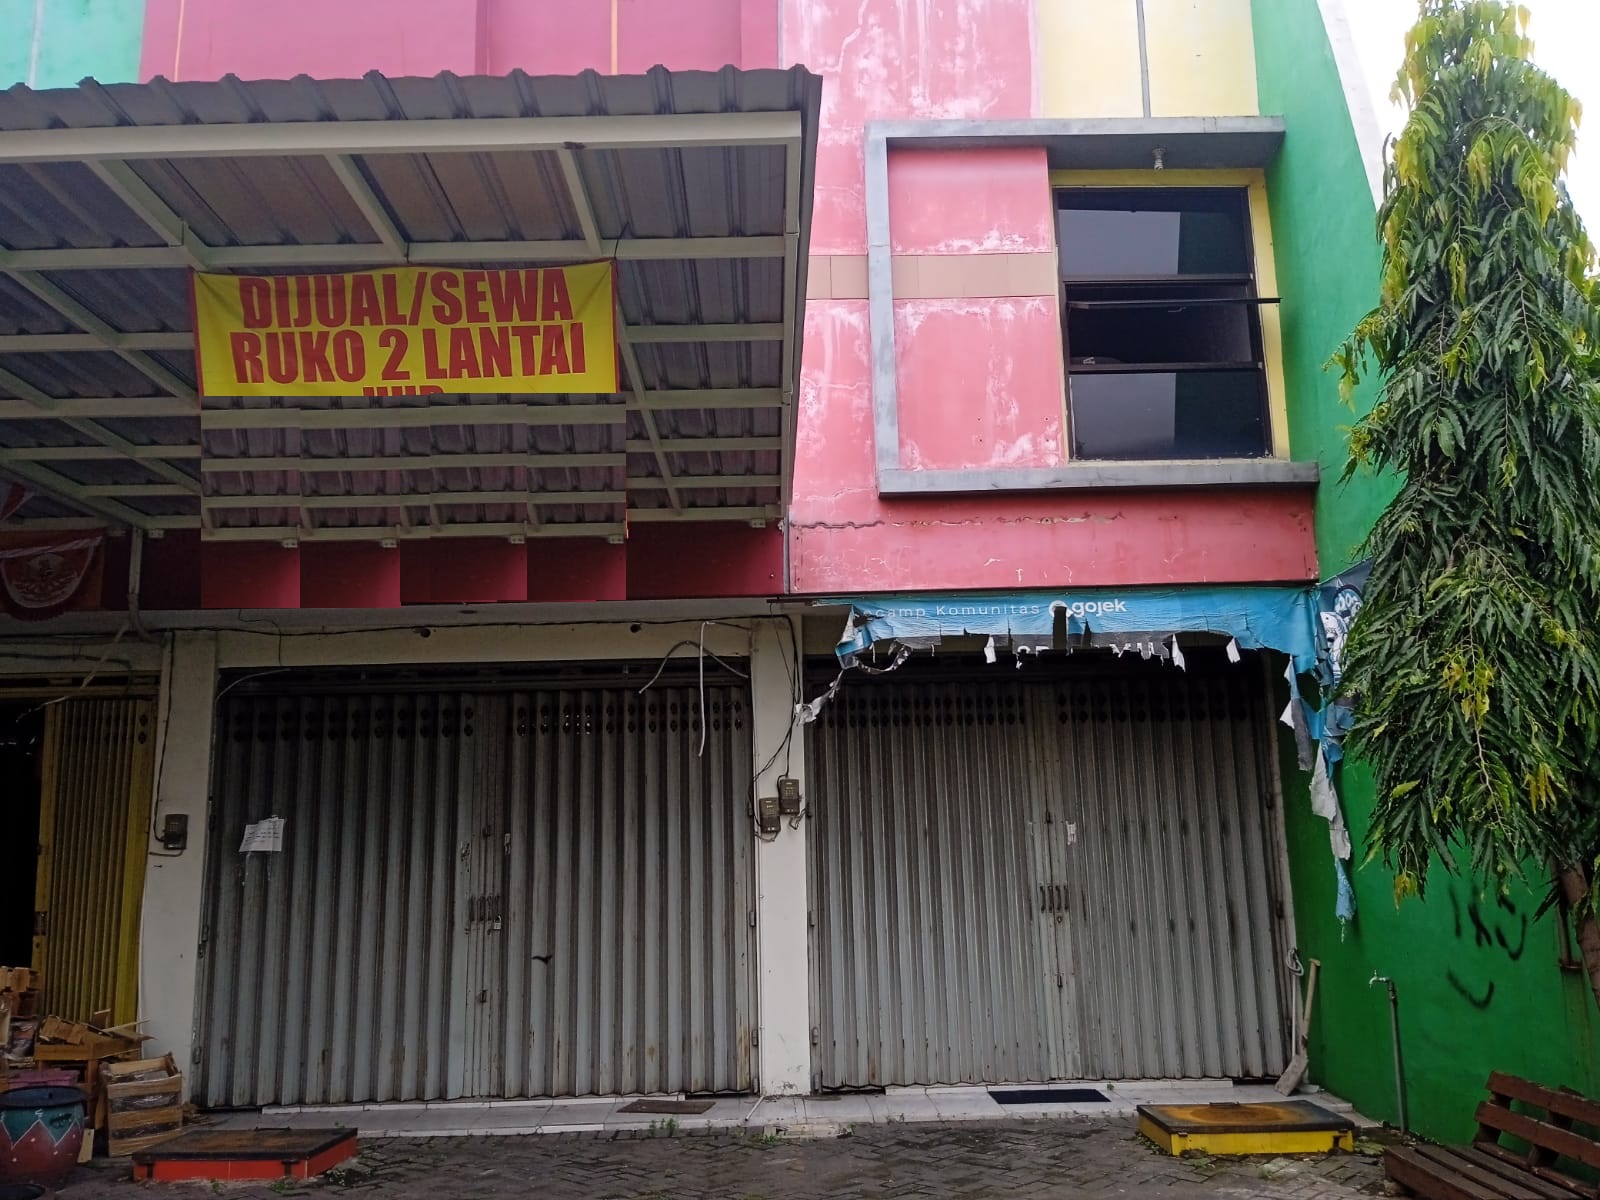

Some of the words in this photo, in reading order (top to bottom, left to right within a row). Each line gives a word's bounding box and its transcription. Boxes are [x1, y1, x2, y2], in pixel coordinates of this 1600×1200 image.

[238, 268, 573, 328] DIJUAL/SEWA
[230, 329, 366, 384] RUKO
[378, 328, 411, 381] 2
[423, 322, 586, 380] LANTAI
[936, 604, 1040, 616] Komunitas
[1072, 599, 1127, 617] gojek
